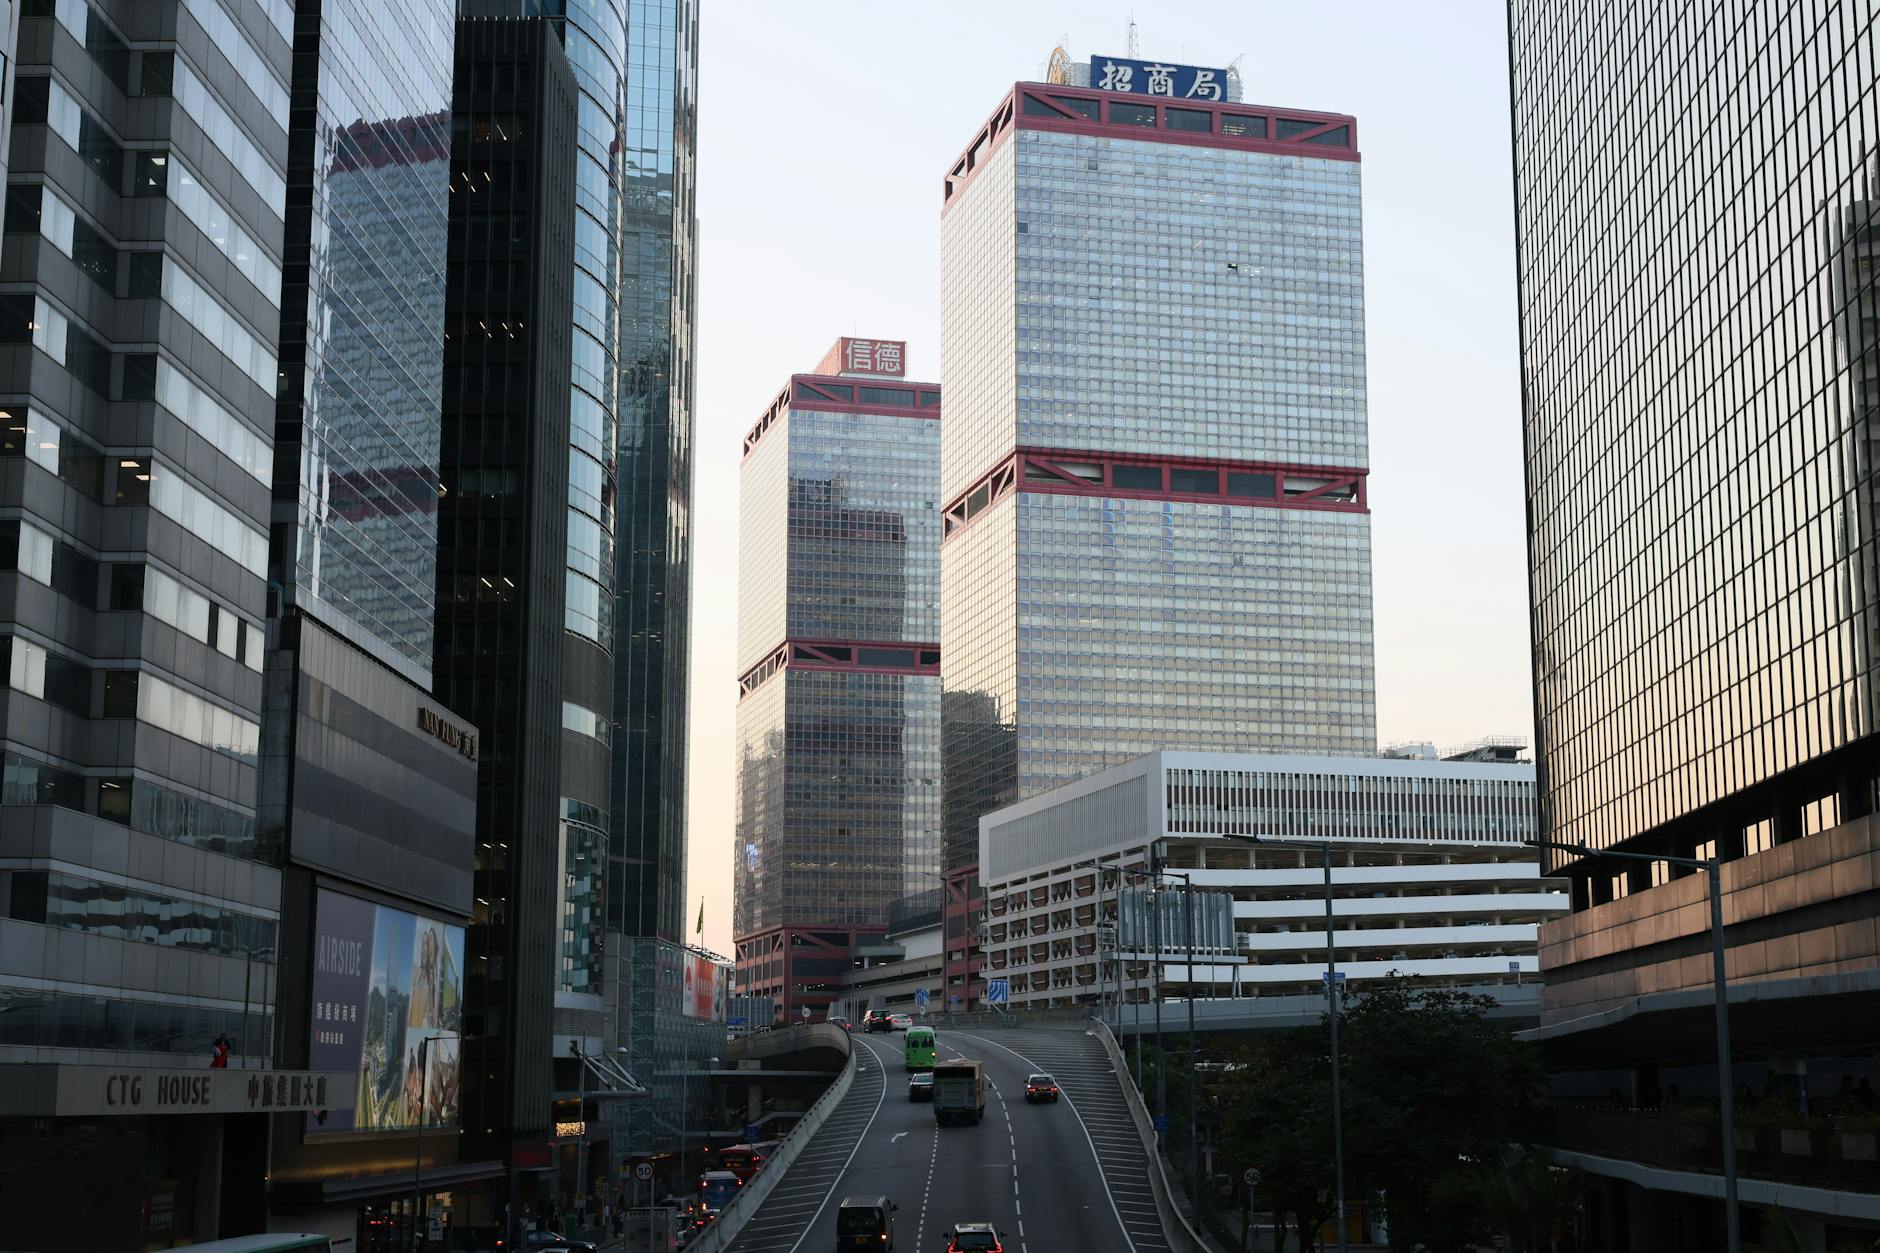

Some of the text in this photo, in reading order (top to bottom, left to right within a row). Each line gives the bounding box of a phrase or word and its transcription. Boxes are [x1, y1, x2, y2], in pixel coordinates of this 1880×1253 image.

[1099, 60, 1222, 101] 招商局
[846, 340, 901, 372] 信德
[319, 935, 361, 976] AIRSIDE
[106, 1075, 210, 1105] CTG HOUSE
[638, 1167, 651, 1176] 50
